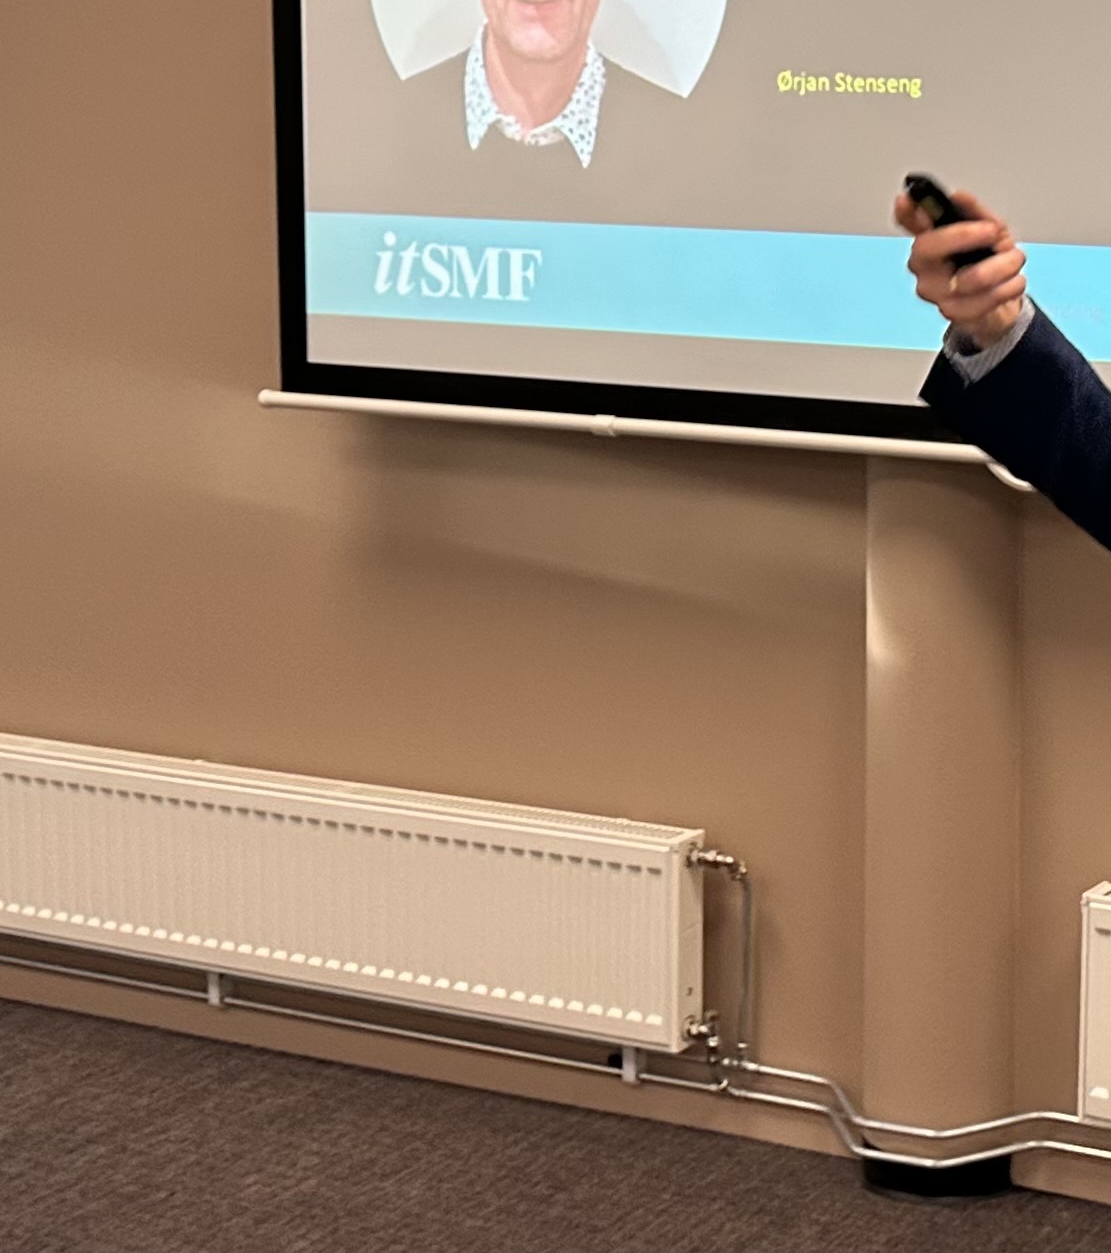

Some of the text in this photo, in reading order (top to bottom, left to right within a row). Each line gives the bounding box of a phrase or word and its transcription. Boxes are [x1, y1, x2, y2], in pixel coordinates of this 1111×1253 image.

[776, 70, 922, 99] Ørjan Stenseng
[375, 231, 543, 301] itSMF
